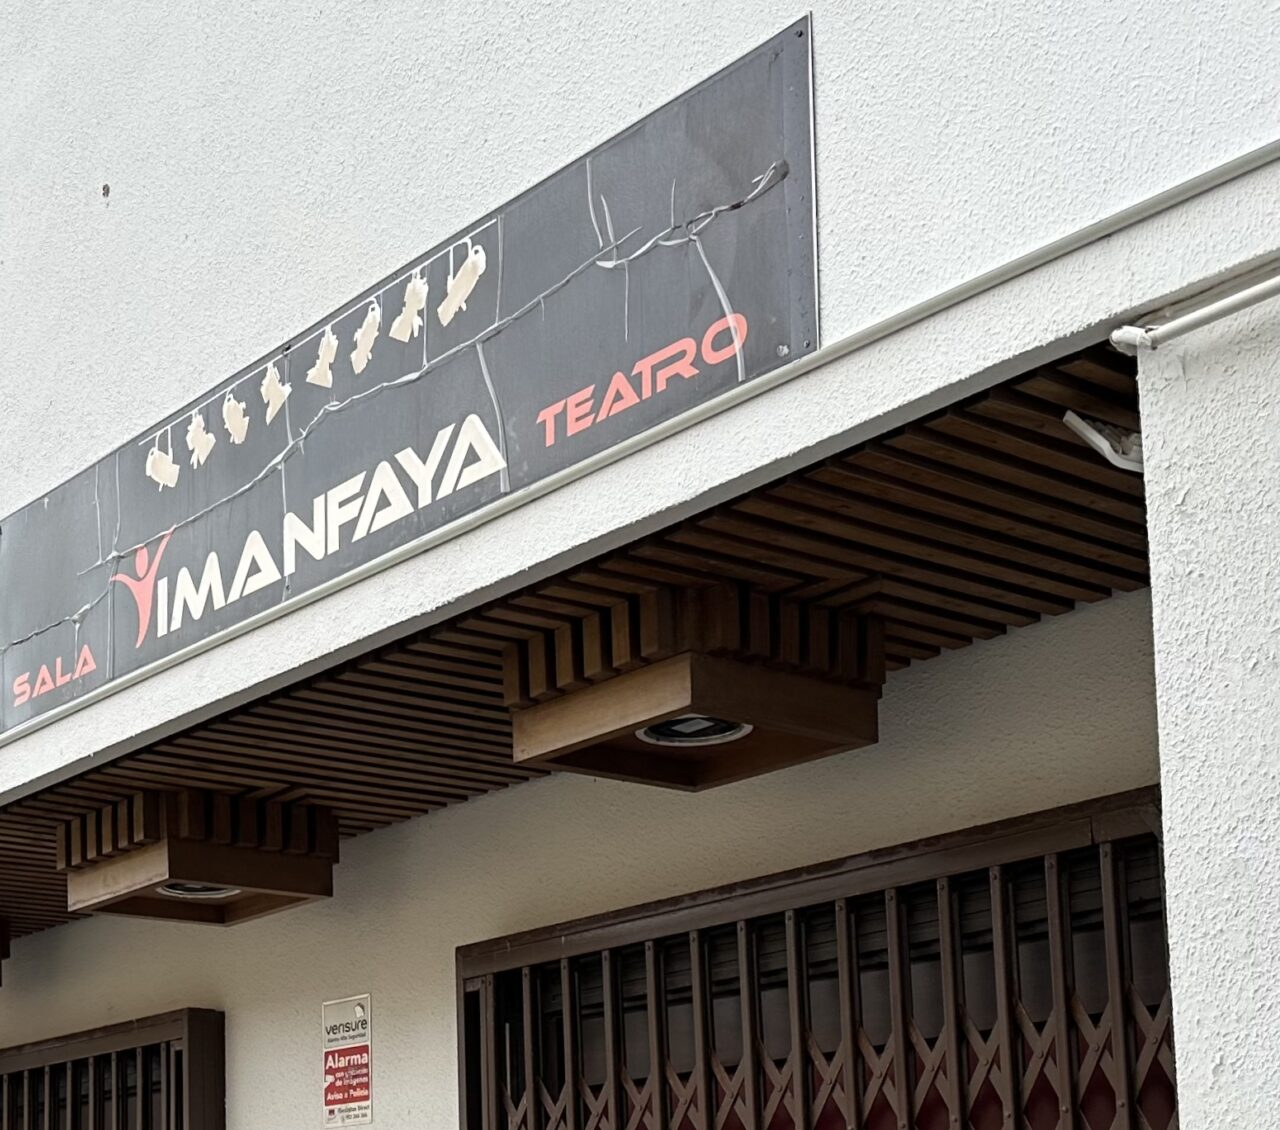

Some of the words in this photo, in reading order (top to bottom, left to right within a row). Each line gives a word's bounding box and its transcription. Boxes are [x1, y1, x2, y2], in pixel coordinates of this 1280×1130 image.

[13, 644, 97, 707] SALA
[536, 312, 748, 447] TEATRO
[325, 1052, 368, 1070] Alarma
